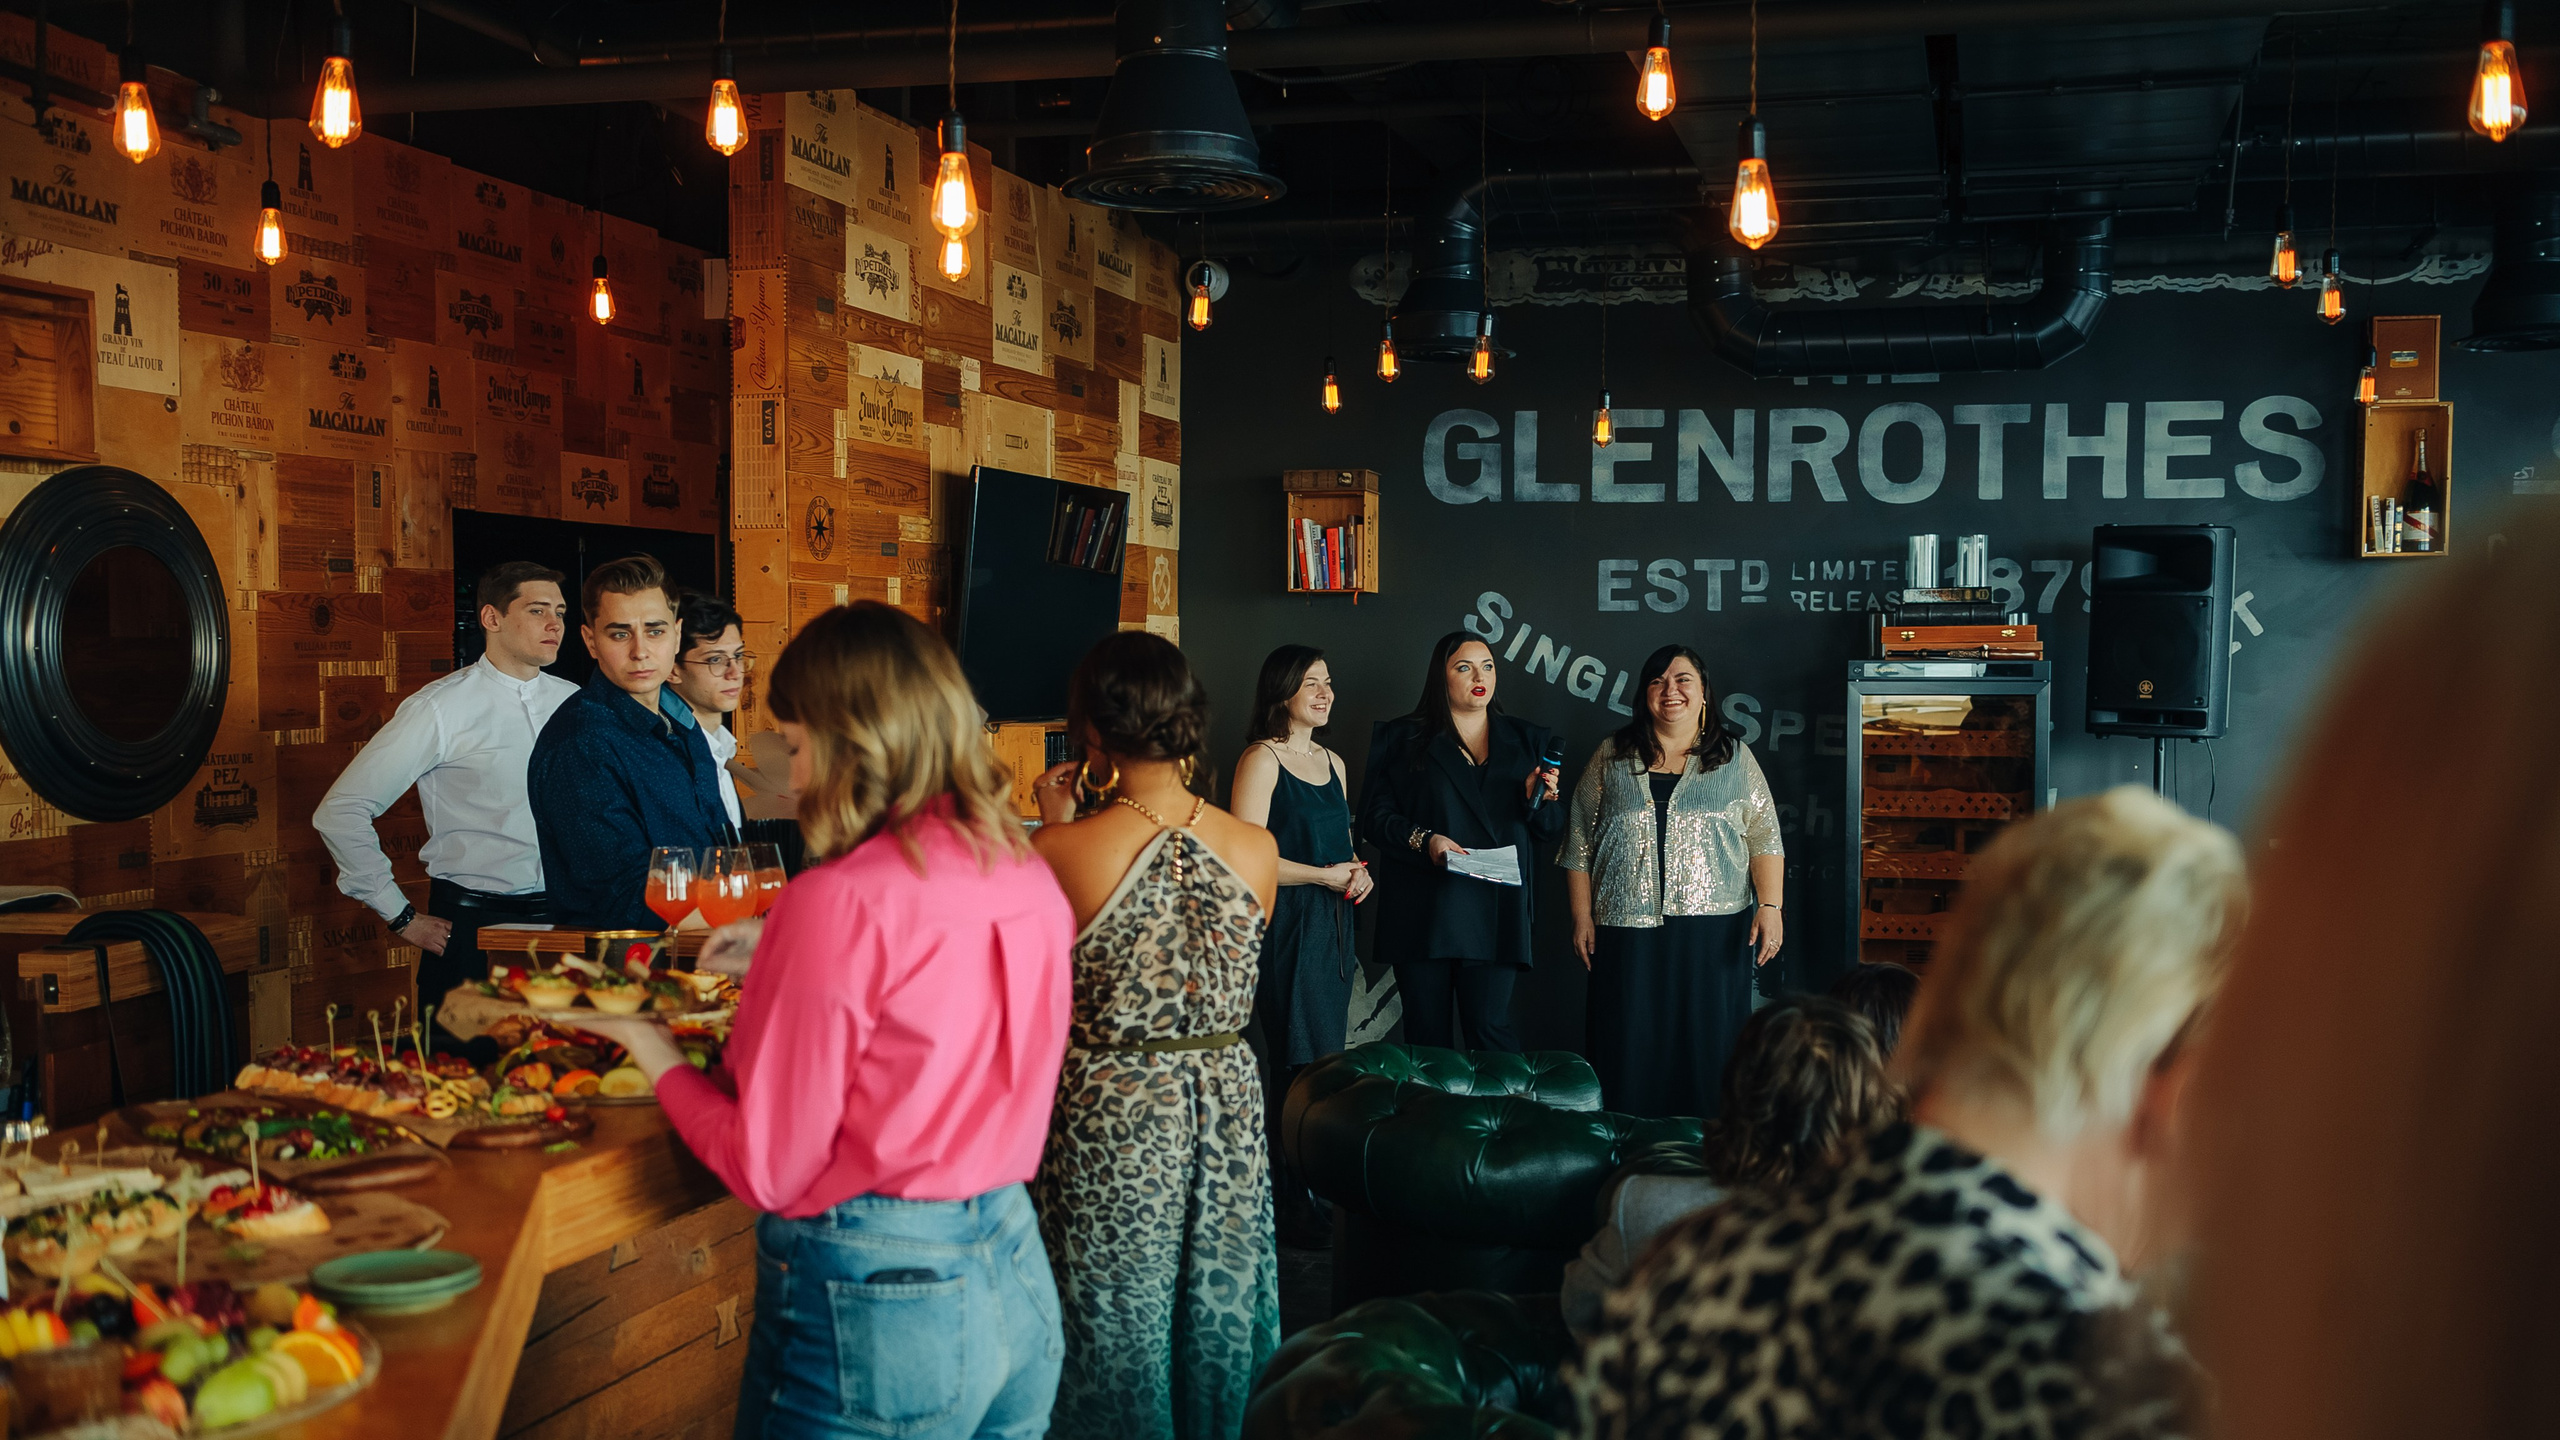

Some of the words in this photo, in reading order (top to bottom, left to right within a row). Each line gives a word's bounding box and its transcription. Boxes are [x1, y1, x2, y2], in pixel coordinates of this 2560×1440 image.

[813, 122, 829, 145] The
[791, 134, 854, 178] MACALLAN
[53, 164, 77, 188] The
[10, 175, 120, 225] MACALLAN
[174, 207, 215, 229] CHÂTEAU
[309, 208, 339, 227] LATOUR
[795, 205, 839, 238] SASSICAIA
[160, 219, 196, 241] PICHON
[197, 230, 229, 248] BARON
[457, 229, 523, 264] MACALLAN
[863, 258, 894, 281] PETRUS
[1098, 248, 1134, 279] MACALLAN
[299, 284, 341, 304] PETRUS
[459, 303, 494, 320] PETRUS
[102, 333, 129, 347] GRAND
[130, 336, 144, 349] VIN
[995, 322, 1039, 351] MACALLAN
[128, 354, 164, 373] LATOUR
[223, 397, 262, 415] CHÂTEAU
[887, 398, 914, 433] Camps
[211, 411, 243, 429] PICHON
[245, 416, 275, 432] BARON
[308, 408, 388, 438] MACALLAN
[406, 419, 437, 435] CHATEAU
[438, 423, 463, 437] LATOUR
[764, 406, 773, 439] GAJA
[1423, 396, 2325, 504] GLENROTHES
[652, 464, 669, 479] PEZ
[580, 479, 611, 494] PETRUS
[1157, 485, 1168, 499] PEZ
[1598, 558, 1770, 613] ESTD
[1791, 559, 1909, 582] LIMITE
[1789, 590, 1902, 613] RELEAS
[1463, 590, 1634, 717] SINGL
[241, 753, 254, 764] DE
[213, 768, 241, 786] PEZ
